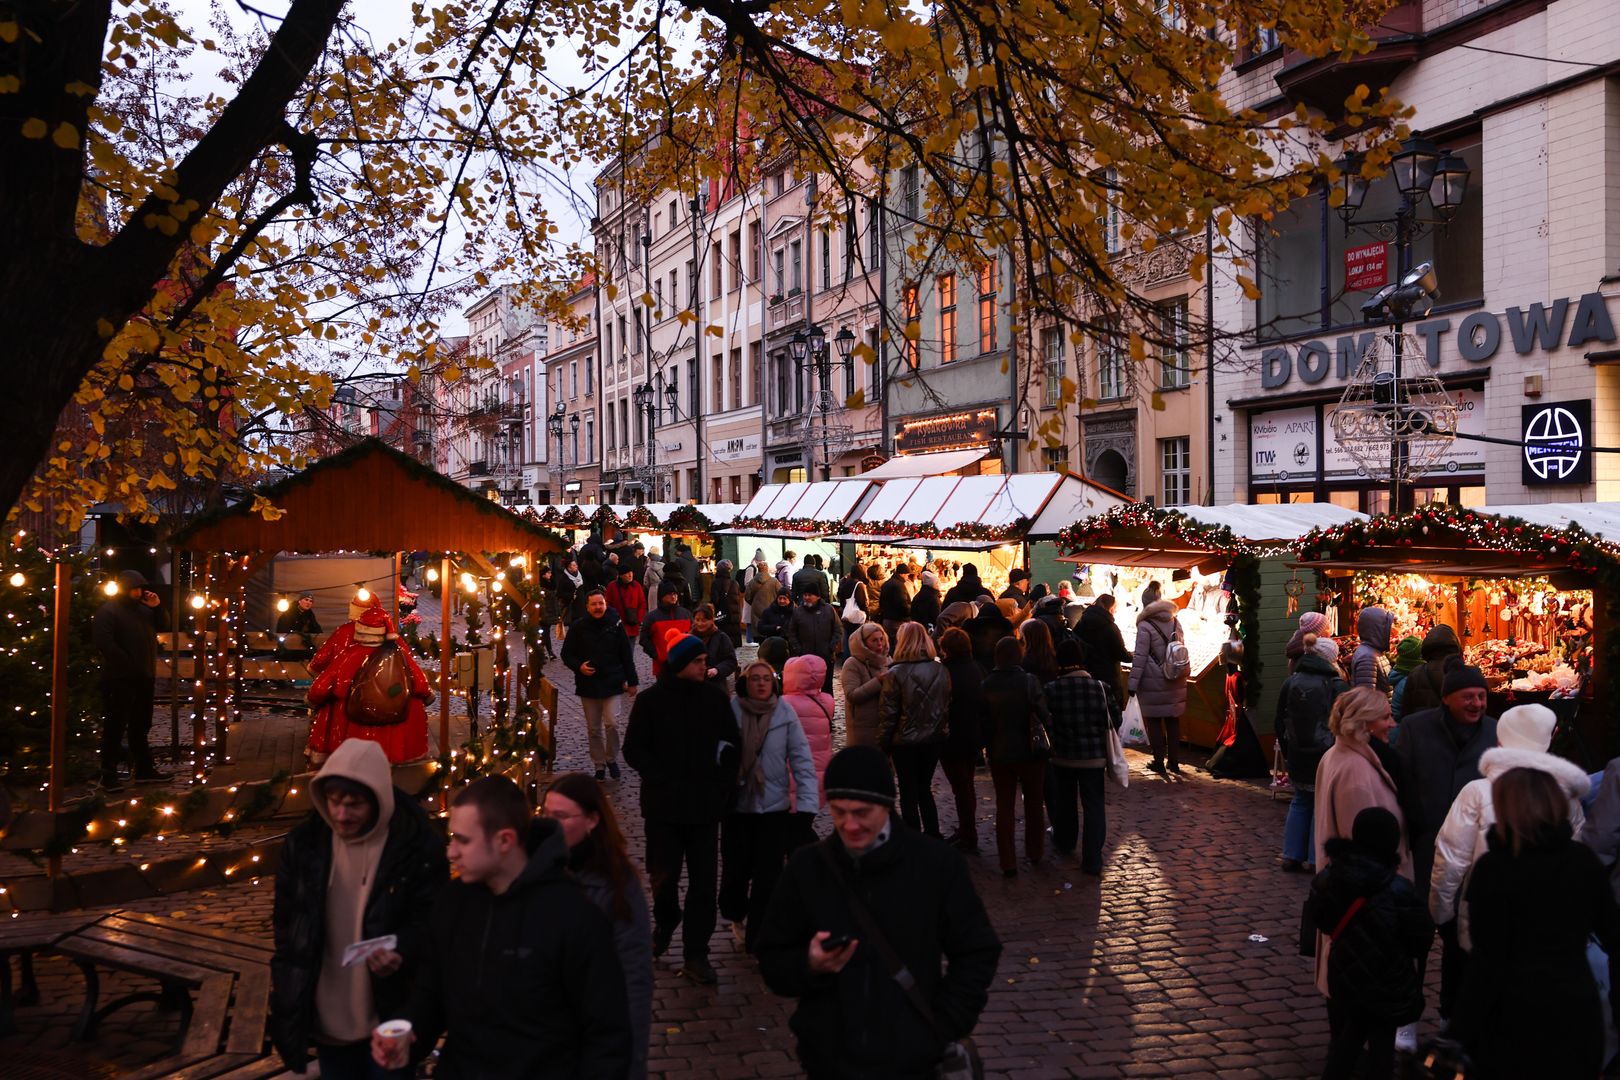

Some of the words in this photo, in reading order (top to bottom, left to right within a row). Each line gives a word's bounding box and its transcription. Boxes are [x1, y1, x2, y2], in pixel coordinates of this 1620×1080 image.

[1347, 252, 1355, 262] DO
[1261, 332, 1378, 388] DOM
[1284, 420, 1317, 435] APART
[910, 438, 927, 446] FISH
[1379, 443, 1390, 451] 973
